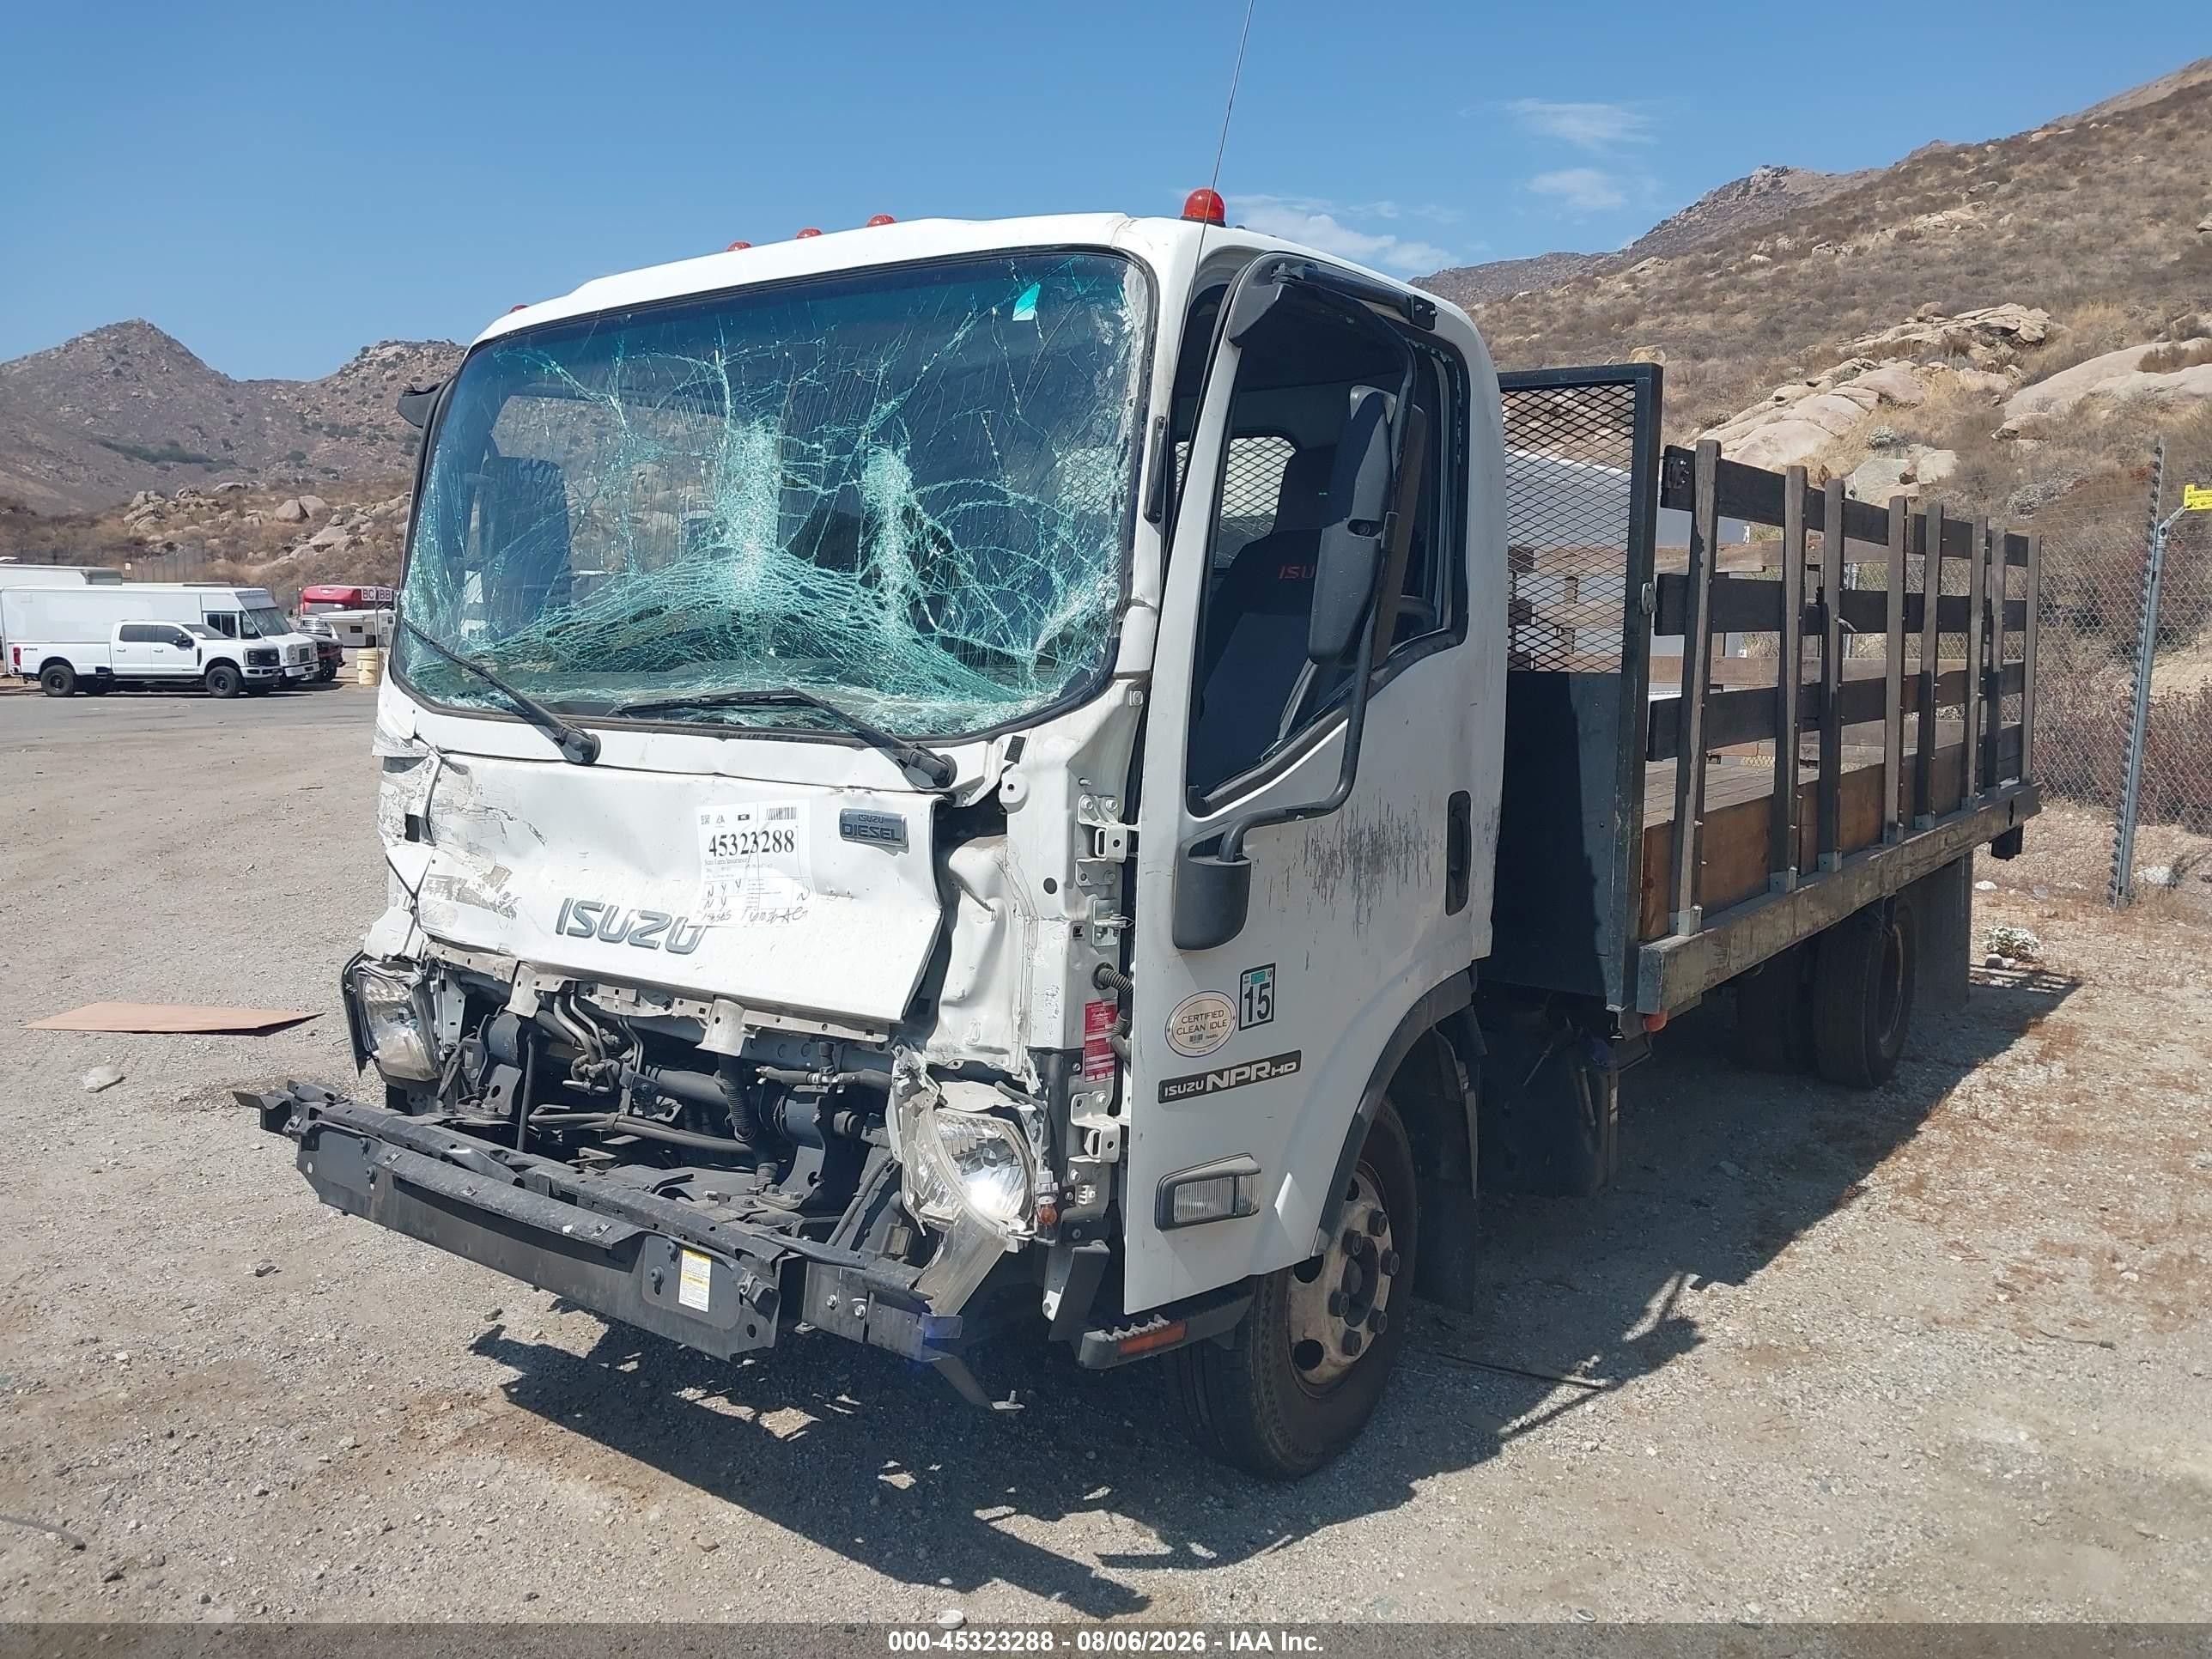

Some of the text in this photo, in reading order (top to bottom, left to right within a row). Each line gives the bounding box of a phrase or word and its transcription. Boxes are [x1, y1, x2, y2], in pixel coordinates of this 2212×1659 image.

[859, 813, 884, 824] ISUZU
[708, 830, 794, 857] 45323288
[842, 823, 901, 842] DIESEL
[555, 897, 708, 956] ISUZU
[1243, 981, 1271, 1023] 15
[1176, 1018, 1228, 1036] CLEAN IDLE
[1181, 1009, 1224, 1024] CERTIFIED
[1164, 1060, 1297, 1097] ISUZU NPR HD
